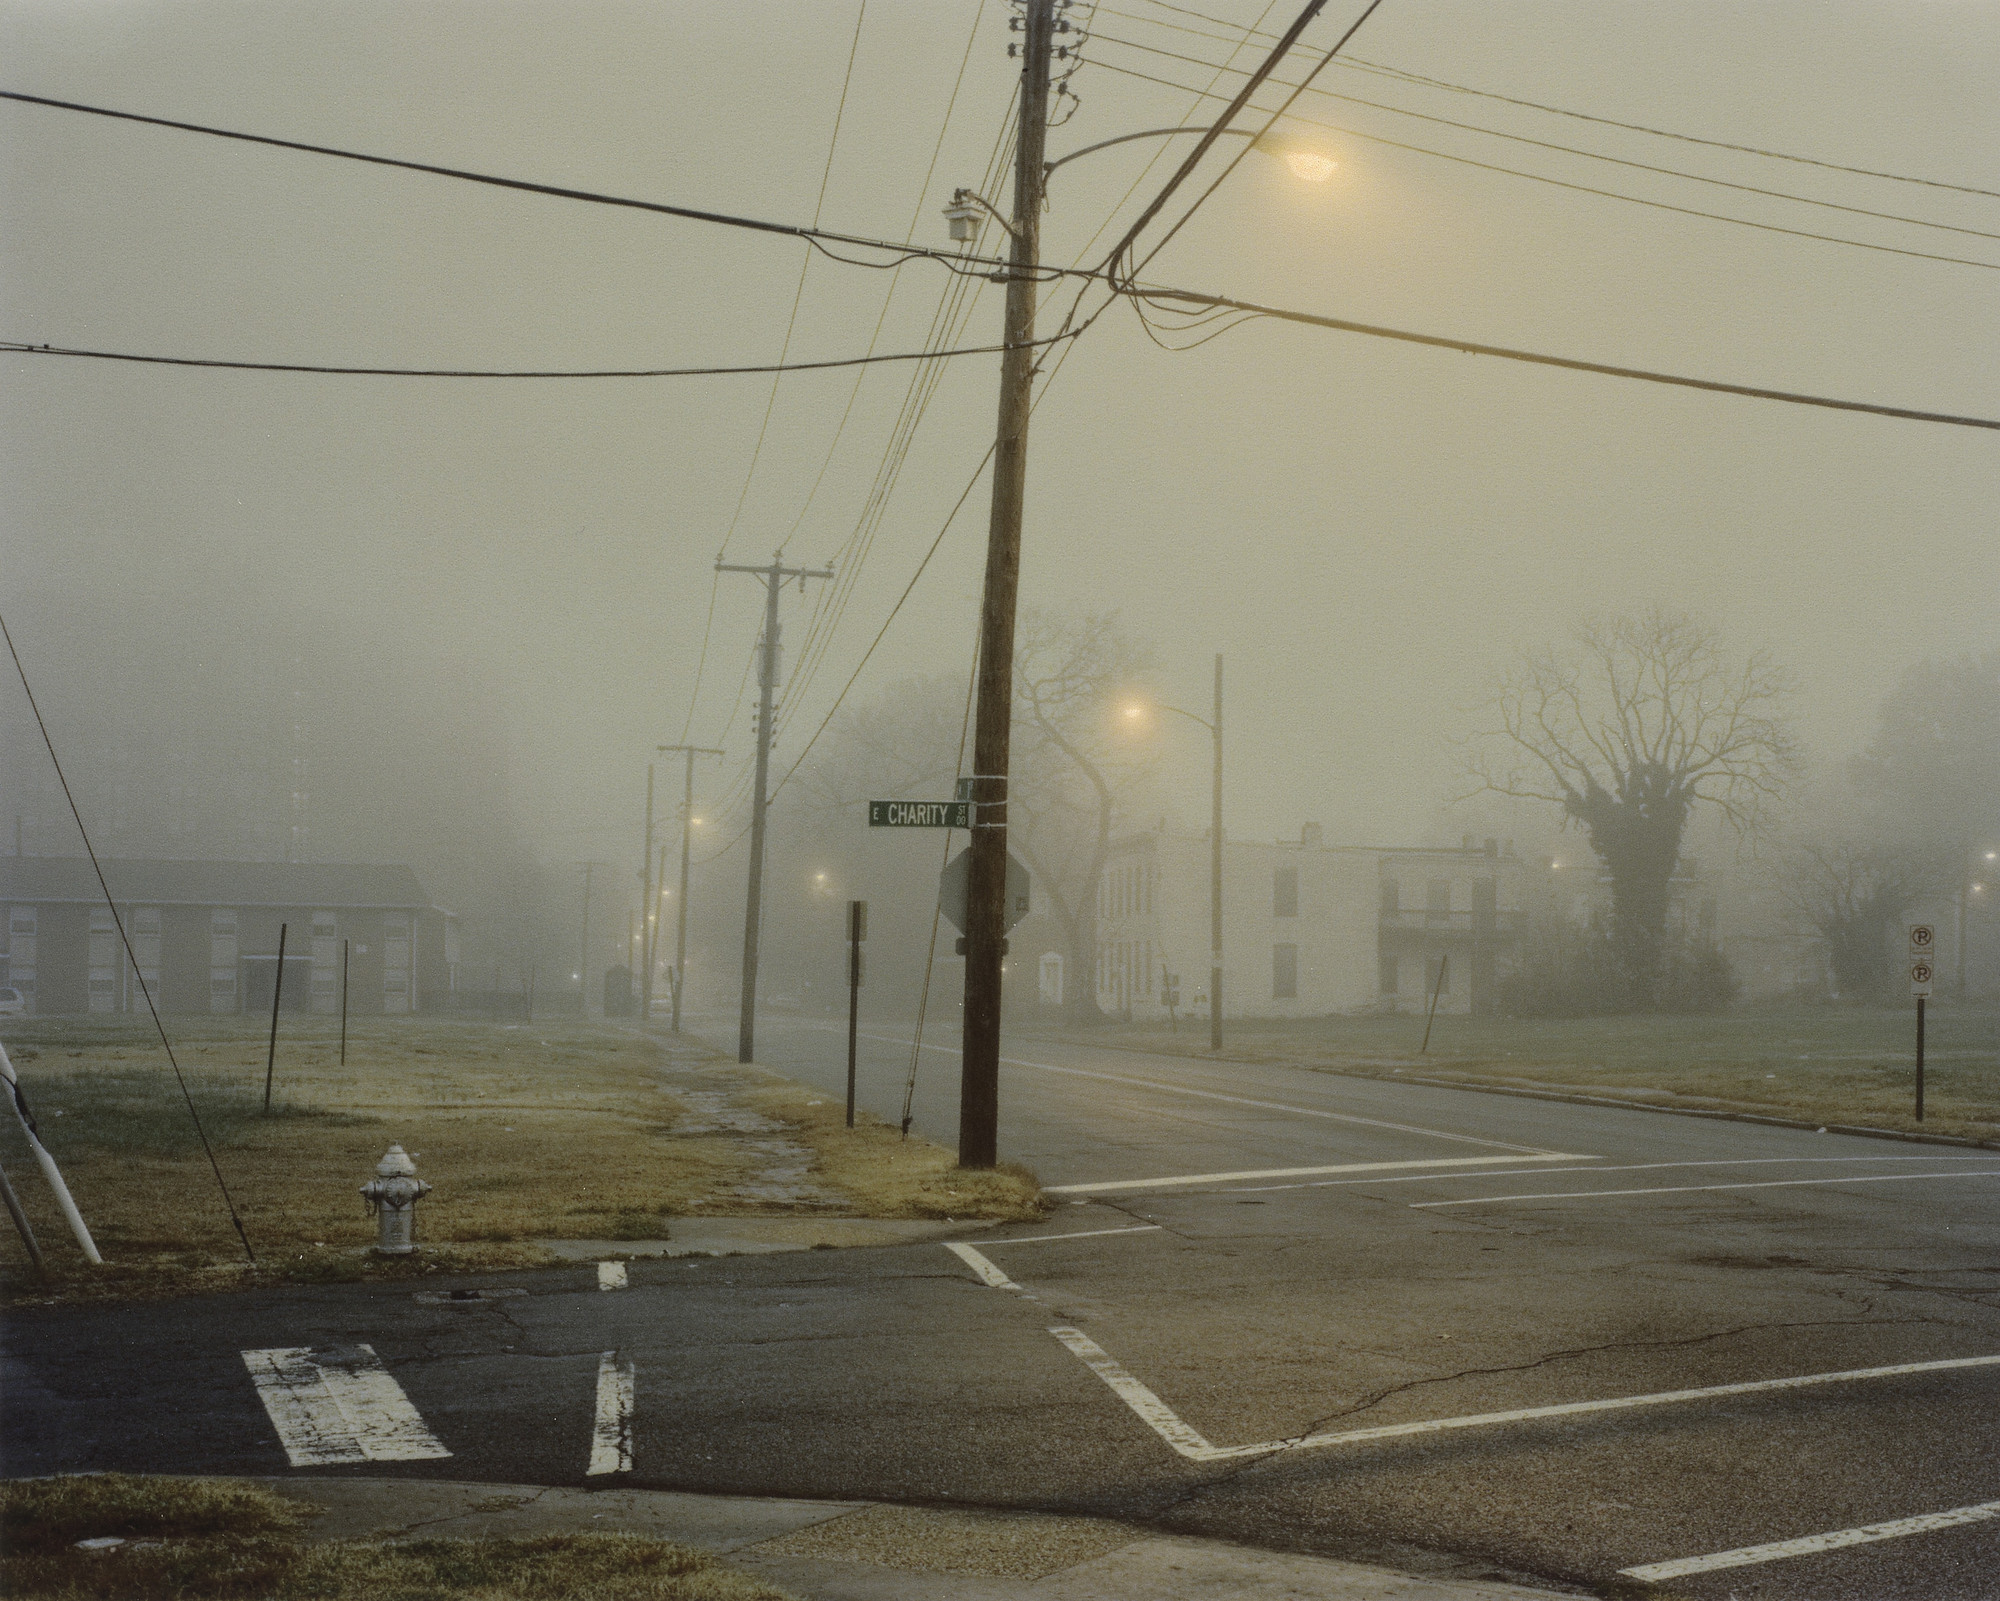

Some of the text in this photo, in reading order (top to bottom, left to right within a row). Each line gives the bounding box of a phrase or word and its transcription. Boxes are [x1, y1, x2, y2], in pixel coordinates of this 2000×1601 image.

[873, 803, 966, 825] E CHARITY ST
